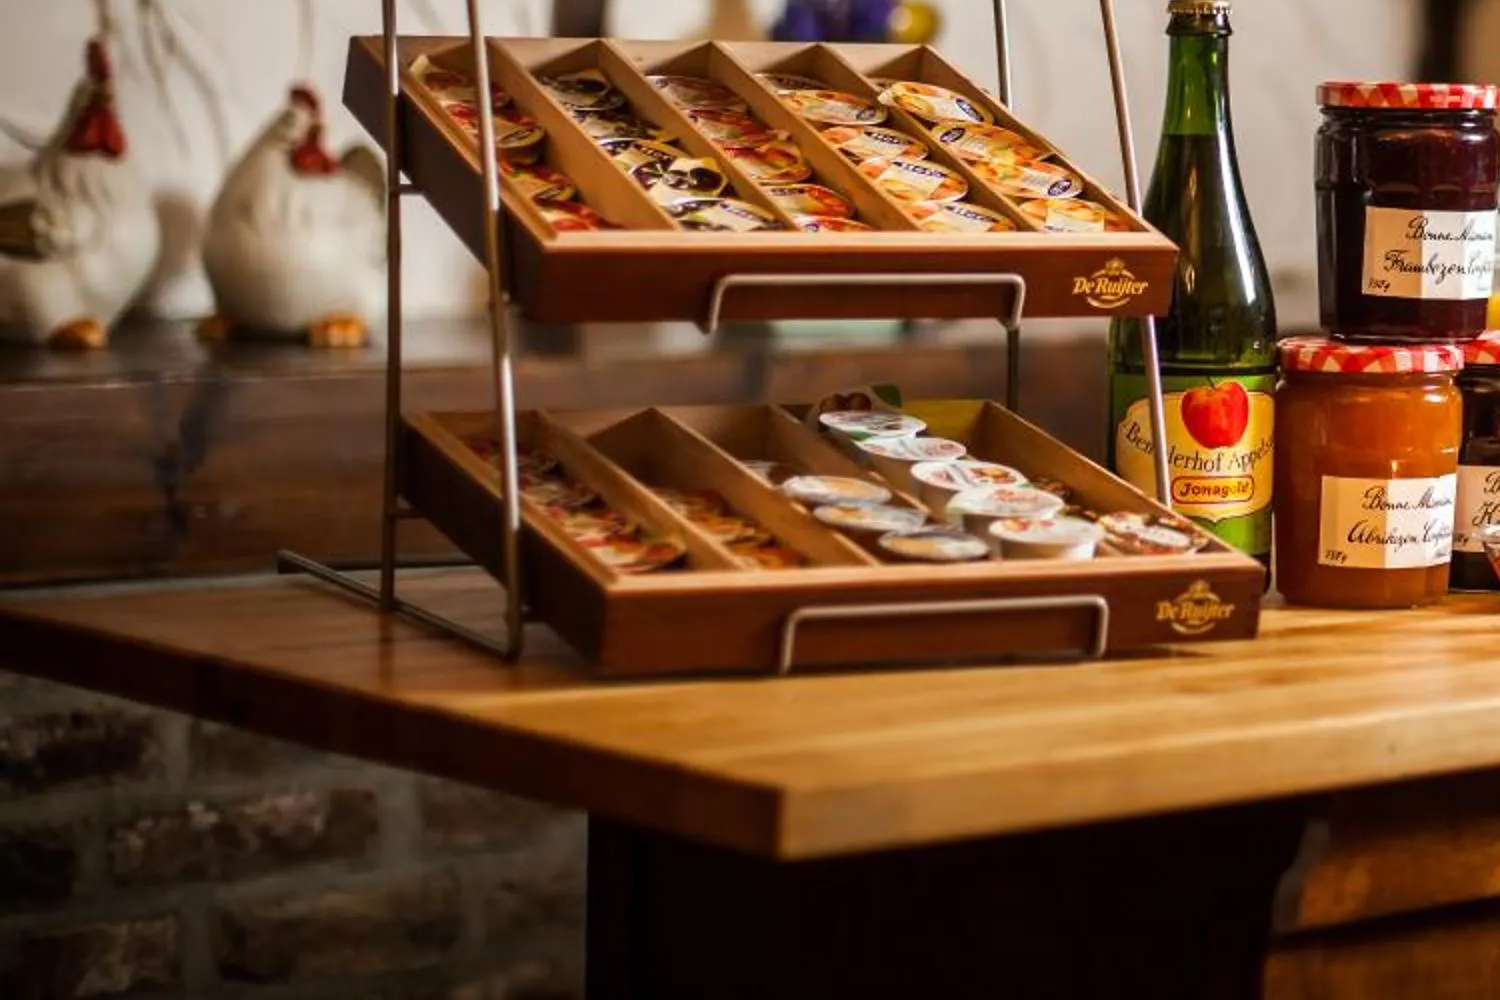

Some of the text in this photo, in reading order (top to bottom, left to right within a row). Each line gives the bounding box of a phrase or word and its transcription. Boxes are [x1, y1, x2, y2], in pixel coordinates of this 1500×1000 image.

[1404, 215, 1454, 241] Bonne
[1072, 276, 1149, 297] De Ruijter
[1179, 481, 1250, 499] Jonagold
[1361, 485, 1411, 511] Bonne
[1156, 600, 1179, 621] De
